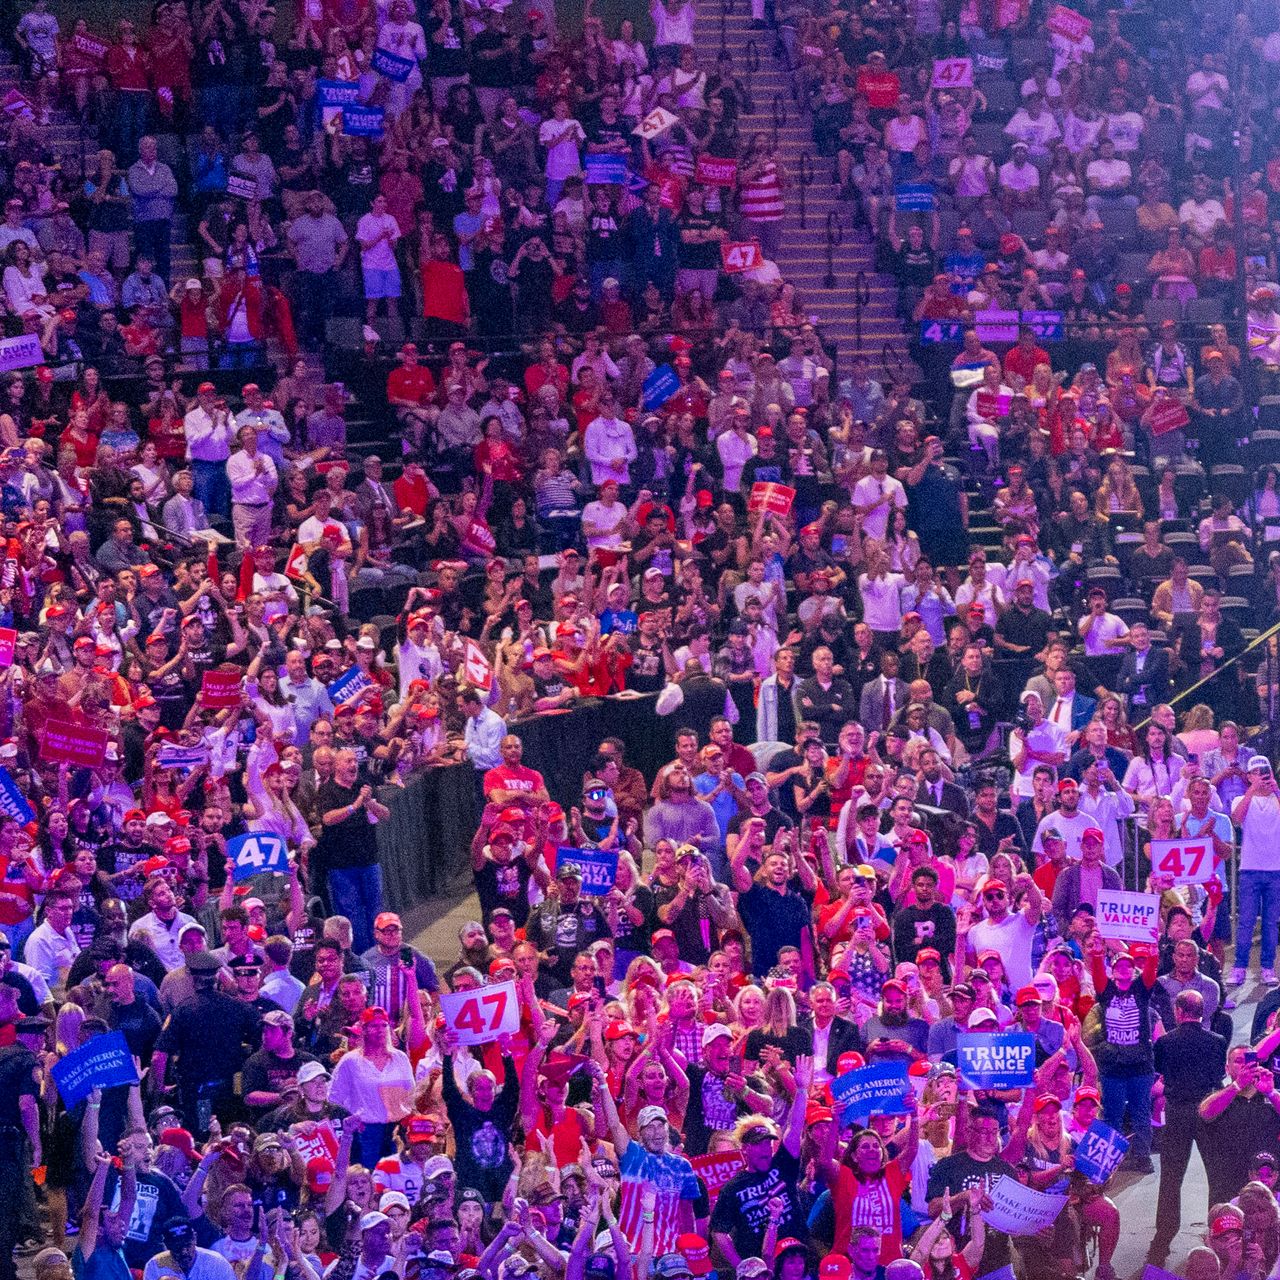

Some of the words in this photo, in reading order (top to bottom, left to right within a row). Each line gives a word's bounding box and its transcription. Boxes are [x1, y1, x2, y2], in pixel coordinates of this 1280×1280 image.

[592, 216, 619, 231] USA
[730, 246, 759, 268] 47
[237, 836, 281, 867] 47
[1159, 846, 1205, 877] 47
[1100, 902, 1154, 915] TRUMP
[1104, 914, 1148, 925] VANCE
[454, 991, 507, 1035] 47
[1107, 1029, 1140, 1041] TRUMP
[963, 1046, 1032, 1060] TRUMP
[972, 1059, 1025, 1071] VANCE
[864, 1077, 906, 1091] AMERICA
[736, 1168, 780, 1201] TRUMP
